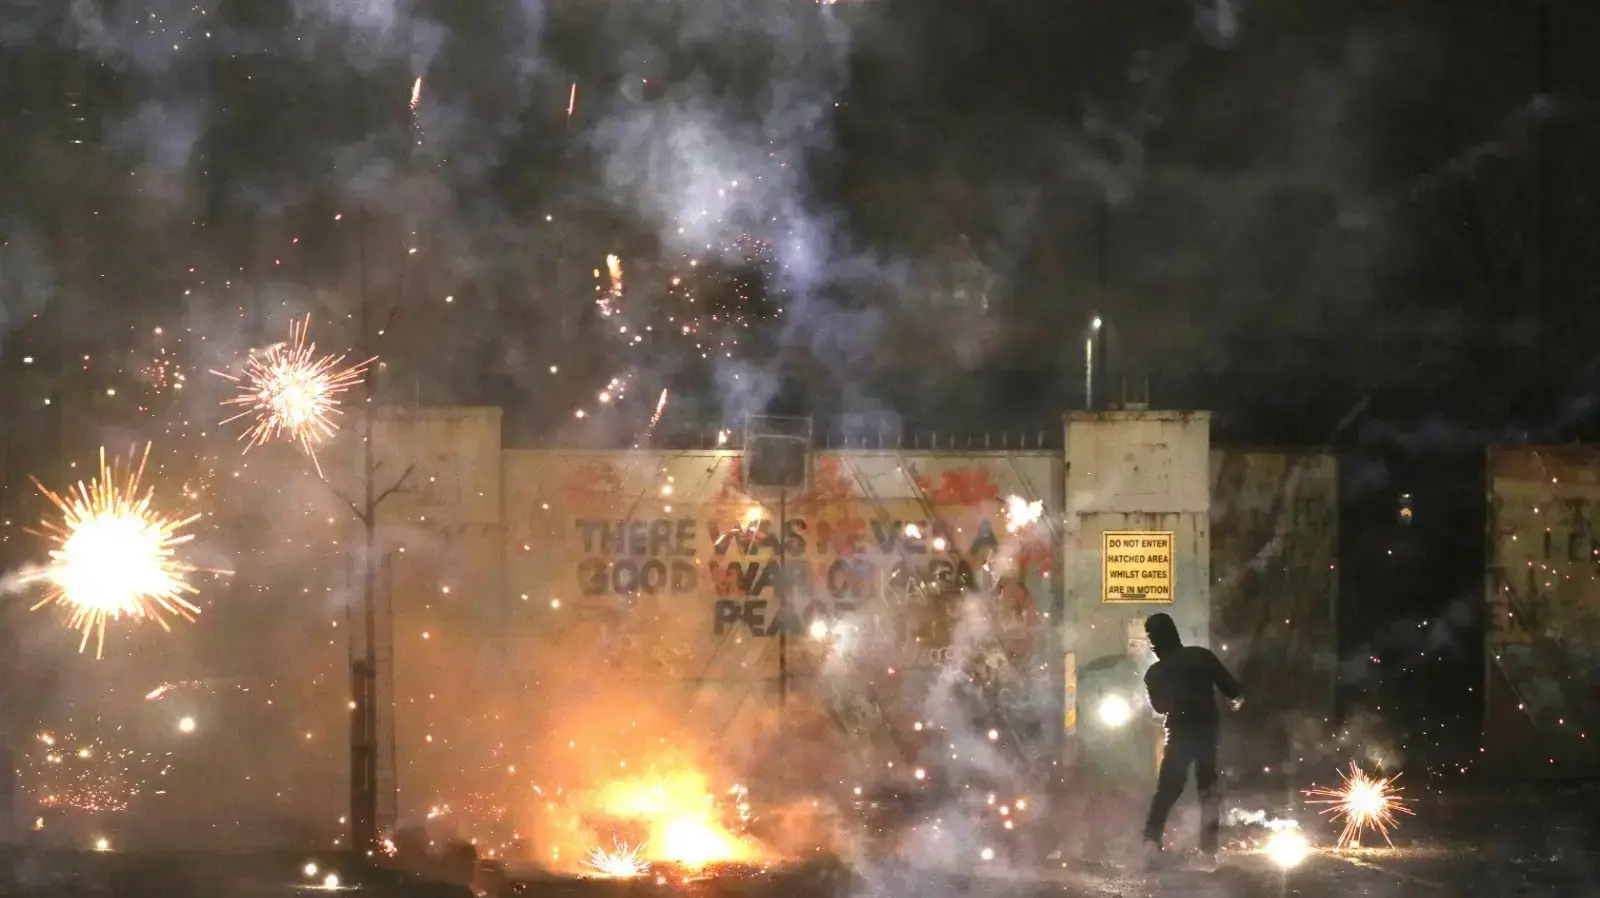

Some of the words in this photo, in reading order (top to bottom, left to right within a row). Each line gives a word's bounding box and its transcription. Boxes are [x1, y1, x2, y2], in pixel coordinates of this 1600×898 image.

[574, 518, 697, 556] THERE
[707, 517, 807, 557] WAS
[968, 518, 999, 555] A
[1109, 539, 1121, 548] DO
[1123, 539, 1139, 548] NOT
[1141, 539, 1168, 548] ENTER
[1108, 555, 1145, 563] HATCHED
[1147, 555, 1169, 563] AREA
[576, 557, 698, 597] GOOD
[1109, 570, 1140, 579] WHILST
[1141, 570, 1167, 579] GATES
[1108, 585, 1125, 594] ARE
[1126, 585, 1135, 594] IN
[1136, 585, 1169, 594] MOTION
[714, 600, 859, 638] PEA
